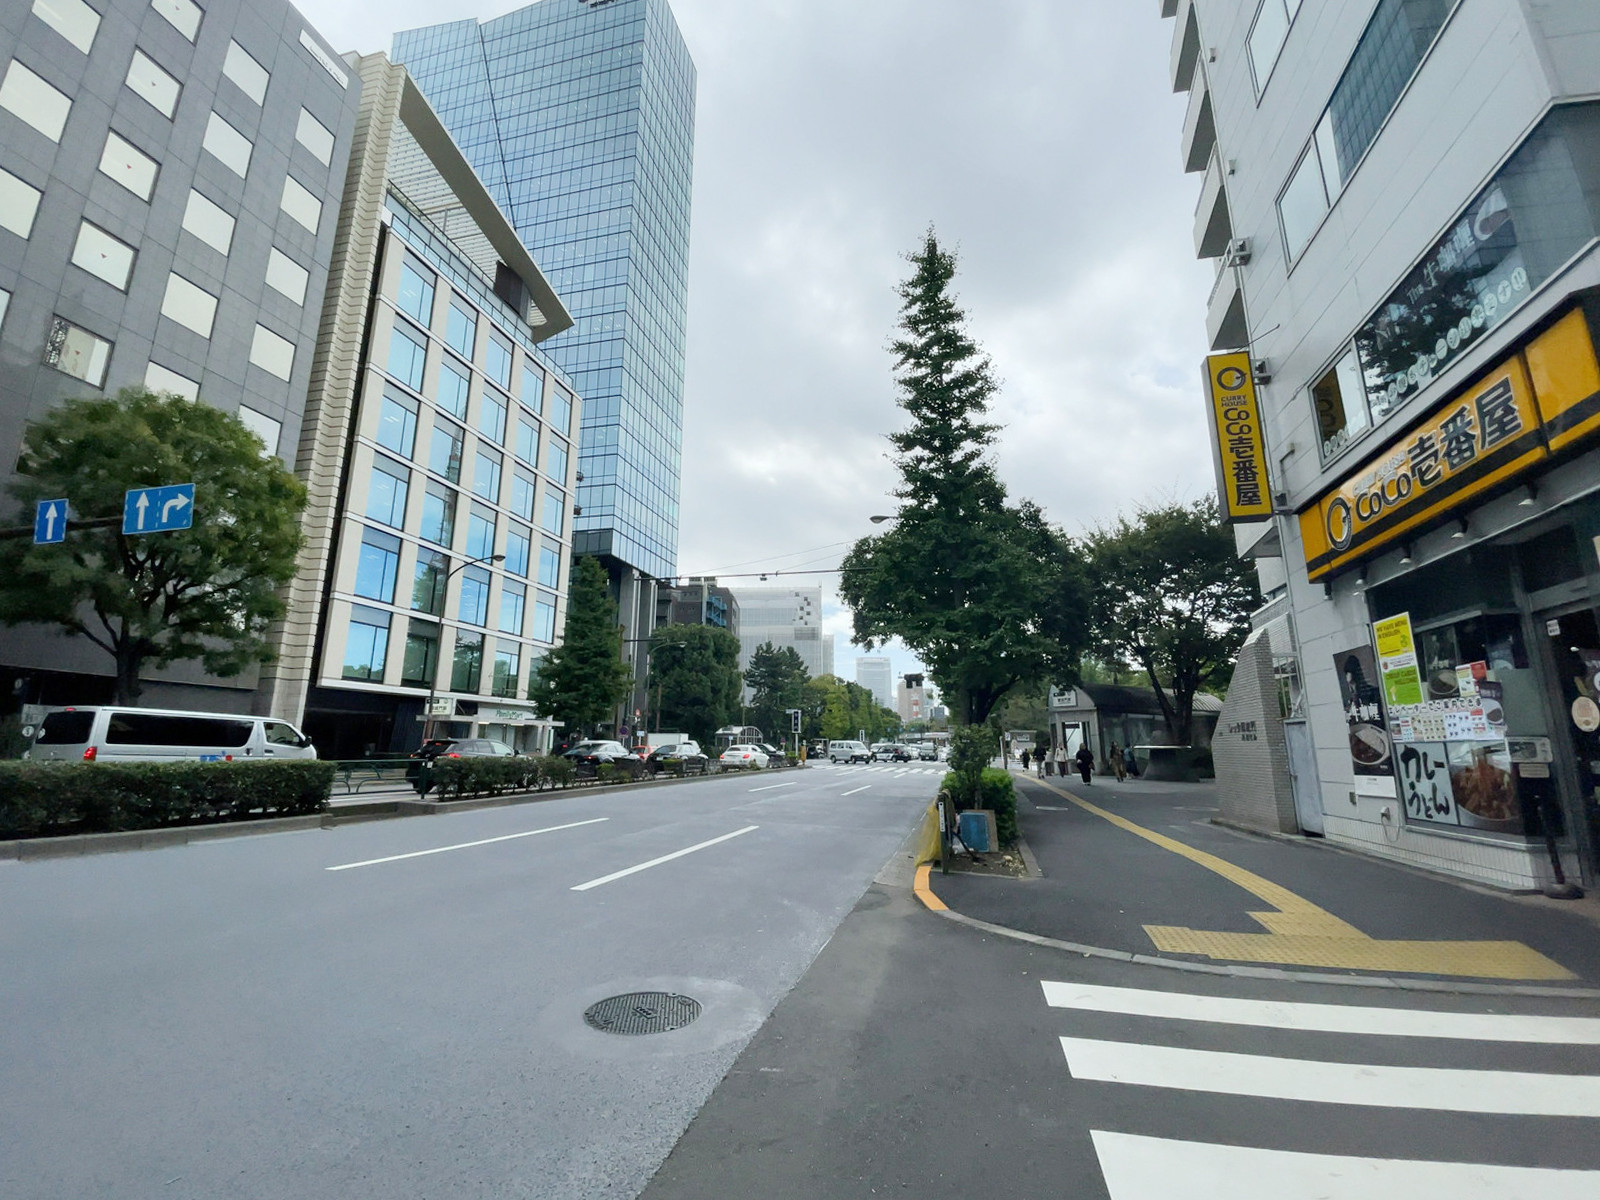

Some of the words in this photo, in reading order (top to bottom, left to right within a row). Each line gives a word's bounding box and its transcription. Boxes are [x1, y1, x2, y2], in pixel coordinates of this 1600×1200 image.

[1221, 394, 1247, 402] CURRY
[1221, 400, 1248, 408] HOUSE
[1400, 745, 1446, 783] カレー
[1408, 781, 1450, 819] うどん
